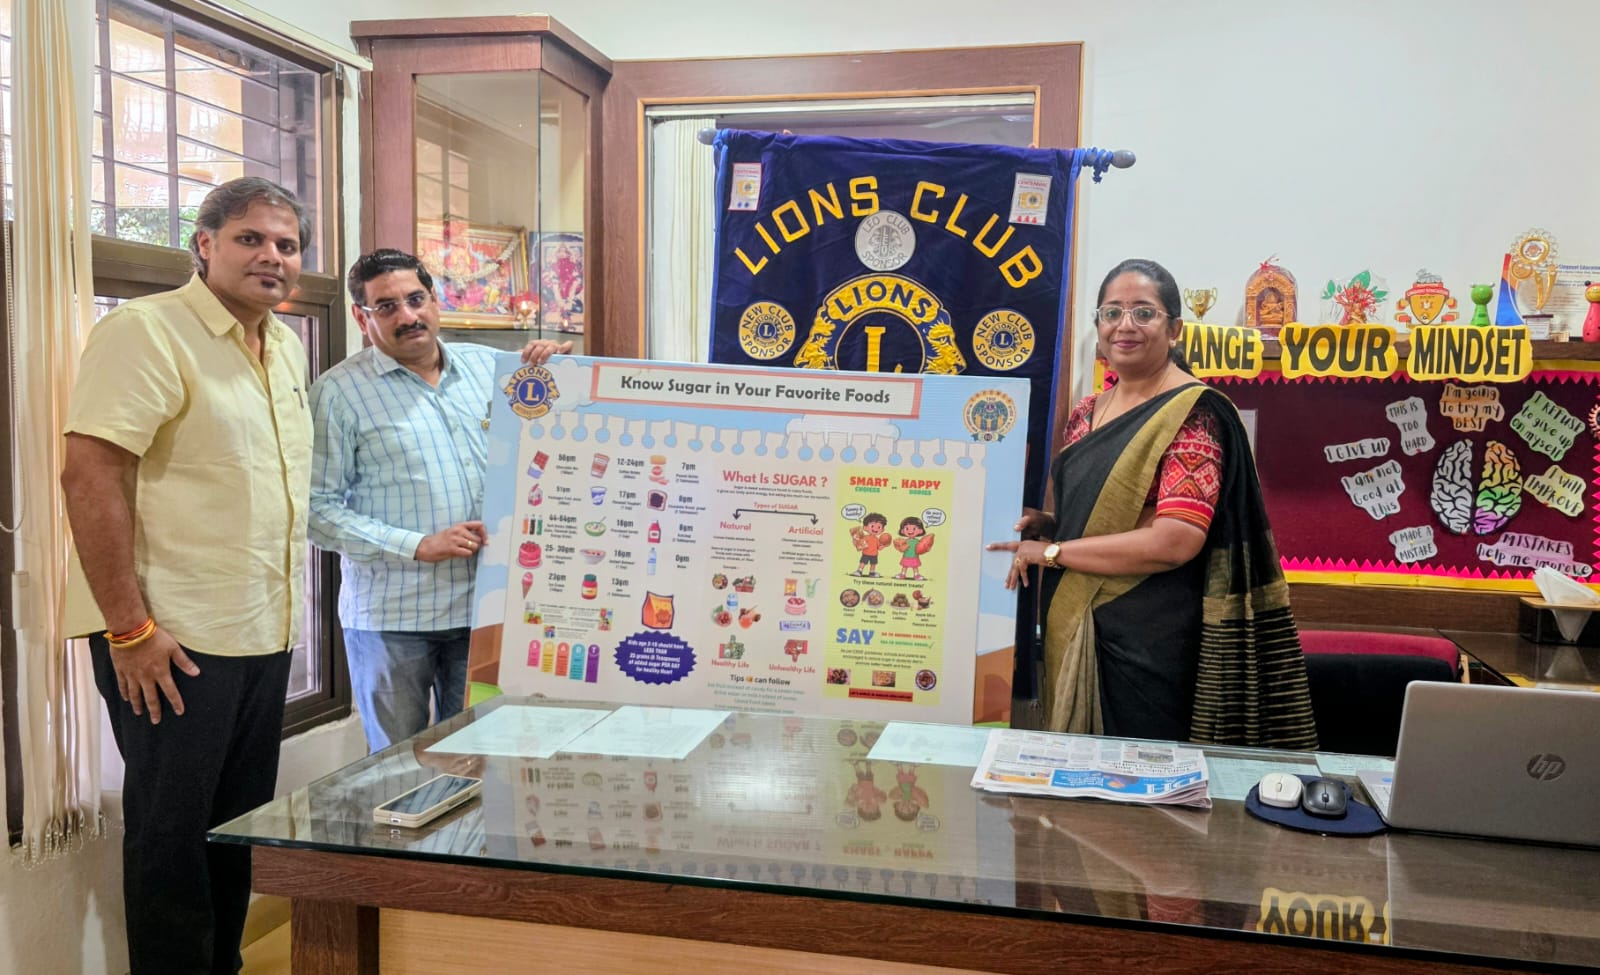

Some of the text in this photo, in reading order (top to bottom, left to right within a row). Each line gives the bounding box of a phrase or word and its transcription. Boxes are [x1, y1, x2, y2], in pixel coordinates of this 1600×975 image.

[734, 176, 1043, 288] LIONS CLUB
[862, 215, 910, 234] LEO CLUB
[862, 251, 908, 268] SPONSOR
[834, 280, 932, 319] LIONS
[742, 306, 793, 331] NEW CLUB
[976, 313, 1032, 340] NEW CLUB
[763, 325, 772, 336] L
[999, 333, 1008, 345] L
[742, 335, 791, 357] SPONSOR
[864, 326, 903, 373] L
[1179, 325, 1525, 376] HANGE YOUR MINDSET
[976, 343, 1030, 368] SPONSOR
[517, 368, 550, 380] LIONS
[525, 382, 539, 401] L
[621, 375, 890, 403] Know Sugar in Your Favorite Foods
[1389, 402, 1418, 417] THIS IS
[1483, 405, 1500, 418] my
[1534, 394, 1582, 432] I REFUSE
[1402, 420, 1419, 432] TOO
[1456, 417, 1484, 430] BEST
[1533, 418, 1558, 436] give
[1326, 448, 1333, 460] I
[1336, 442, 1366, 459] GIVE
[1405, 437, 1427, 451] HARD
[1524, 431, 1562, 459] myself
[723, 470, 828, 486] What Is SUGAR ?
[1548, 468, 1558, 479] I
[849, 476, 941, 490] SMART HAPPY
[1343, 478, 1351, 490] I
[1353, 486, 1382, 505] Good
[1528, 477, 1581, 513] IMPROVE
[720, 521, 824, 535] Natural Artificial
[1394, 536, 1398, 544] I
[1400, 528, 1423, 542] MADE
[1400, 544, 1433, 560] MISTAKE
[1502, 534, 1571, 556] MISTAKES
[1478, 544, 1506, 564] help
[1511, 554, 1530, 565] me
[836, 628, 875, 645] SAY
[1529, 753, 1563, 780] hp
